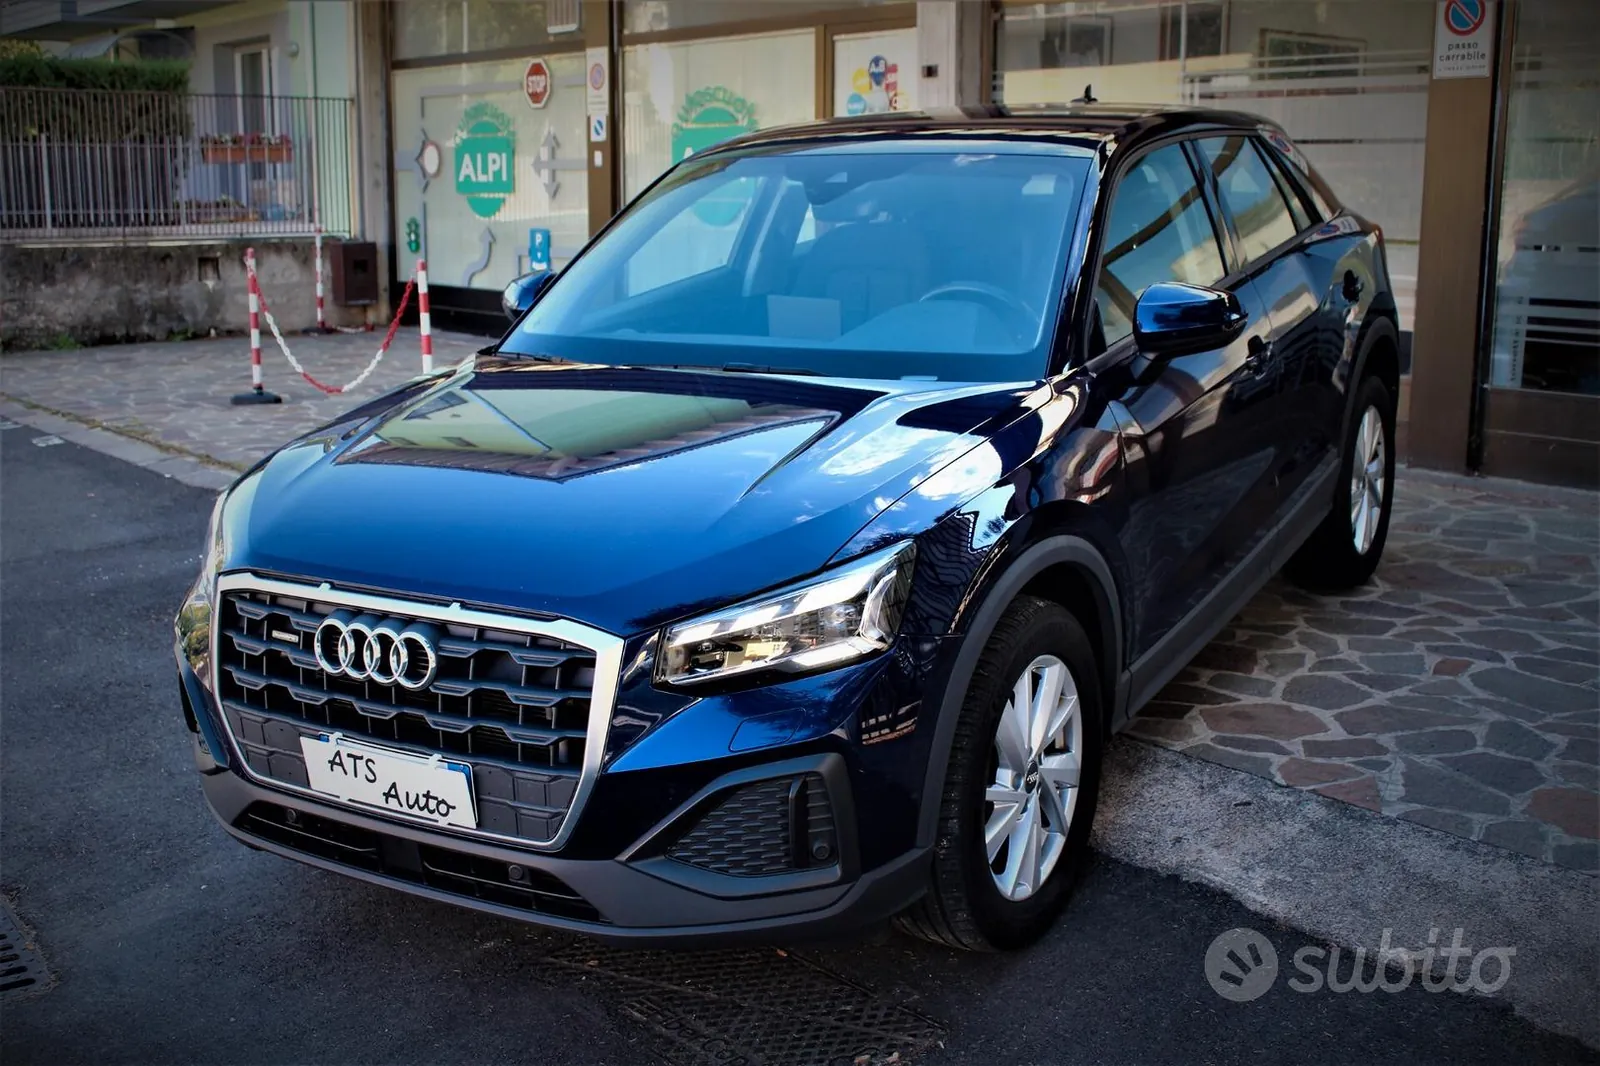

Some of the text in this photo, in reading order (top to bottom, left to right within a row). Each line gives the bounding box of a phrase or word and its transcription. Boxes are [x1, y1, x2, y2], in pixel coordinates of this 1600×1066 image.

[1439, 51, 1486, 62] carrabile
[1447, 42, 1479, 52] passo
[527, 74, 546, 93] STOP
[458, 152, 507, 183] ALPI
[535, 232, 543, 246] P
[328, 750, 377, 783] ATS
[382, 781, 456, 817] Auto
